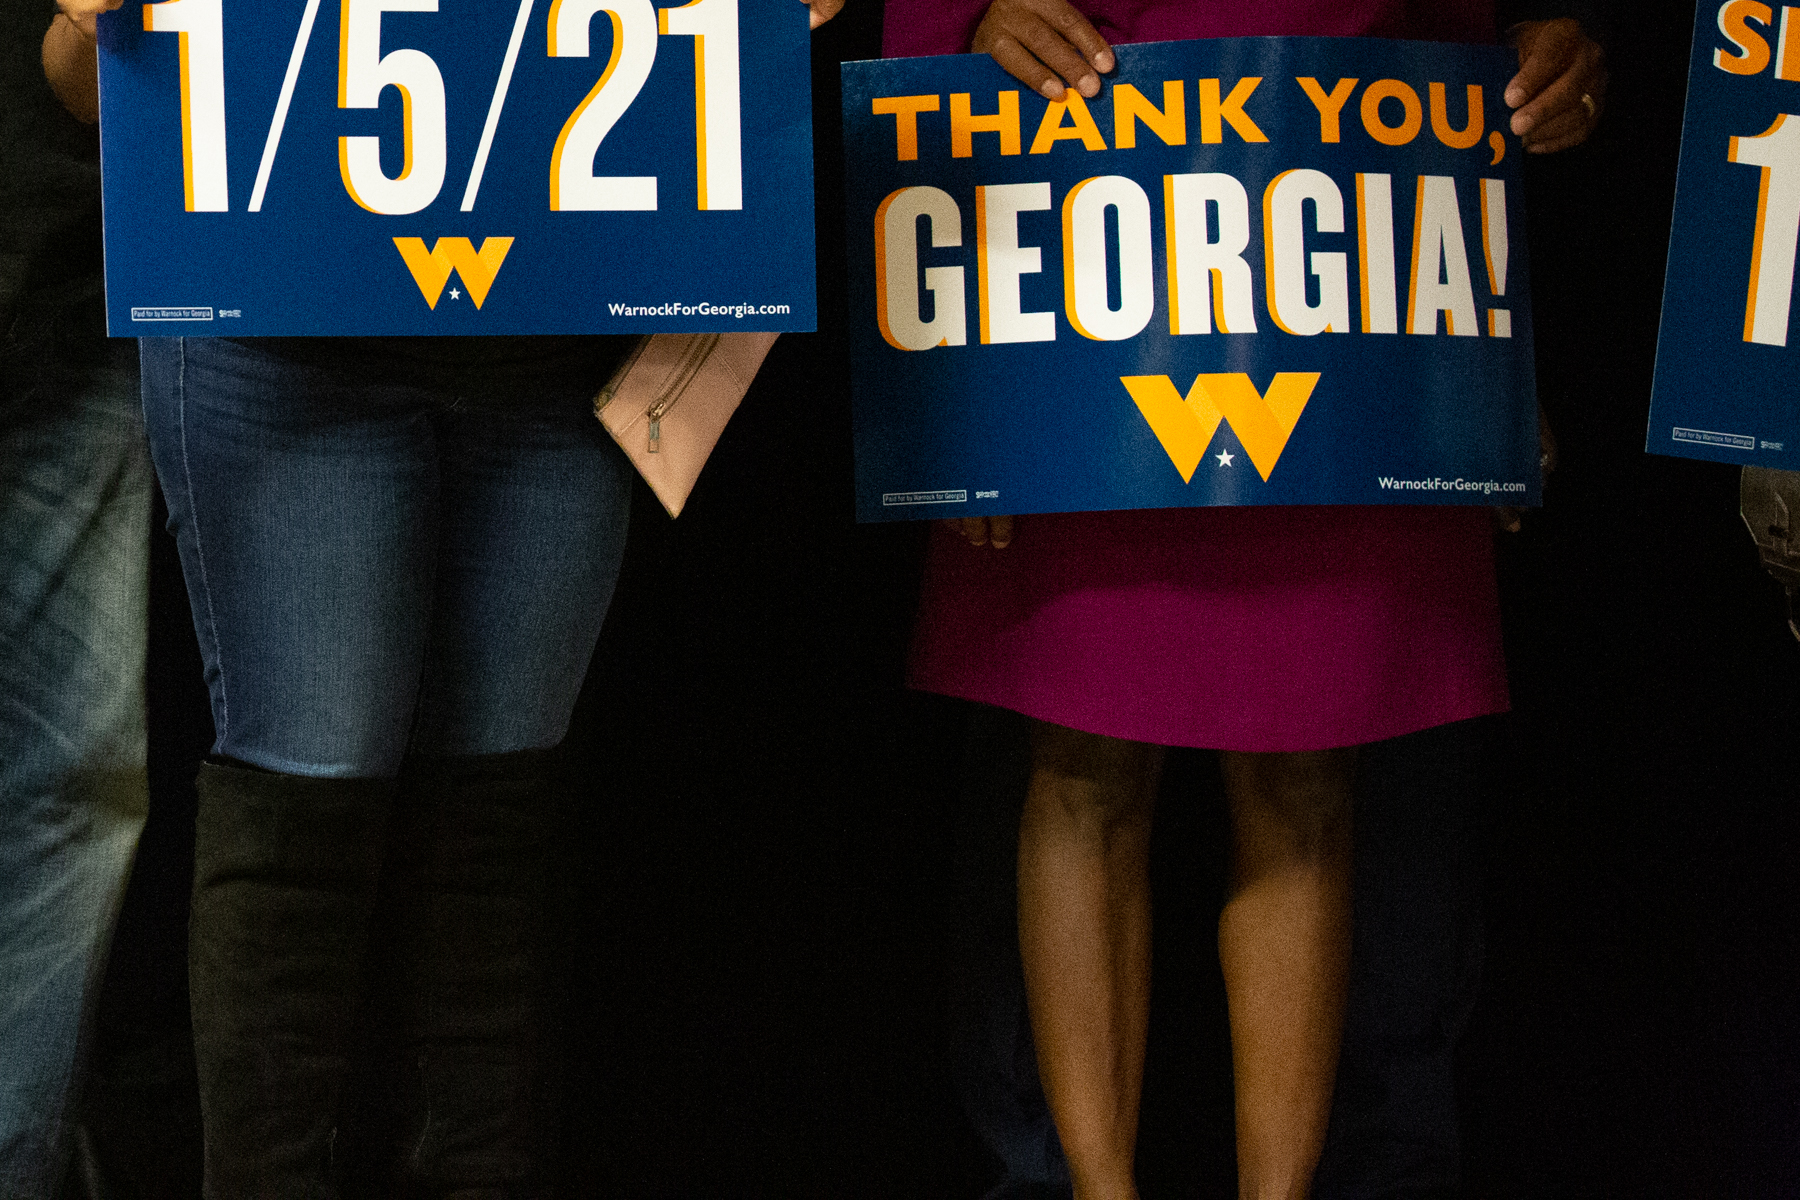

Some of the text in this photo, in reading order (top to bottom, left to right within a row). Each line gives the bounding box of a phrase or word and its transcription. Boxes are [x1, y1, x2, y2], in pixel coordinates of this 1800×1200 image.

[872, 76, 1505, 166] THANK YOU,
[874, 168, 1512, 351] GEORGIA!
[608, 302, 791, 319] WarnockForGeorgia.com
[1378, 476, 1526, 495] WarnockForGeorgia.com
